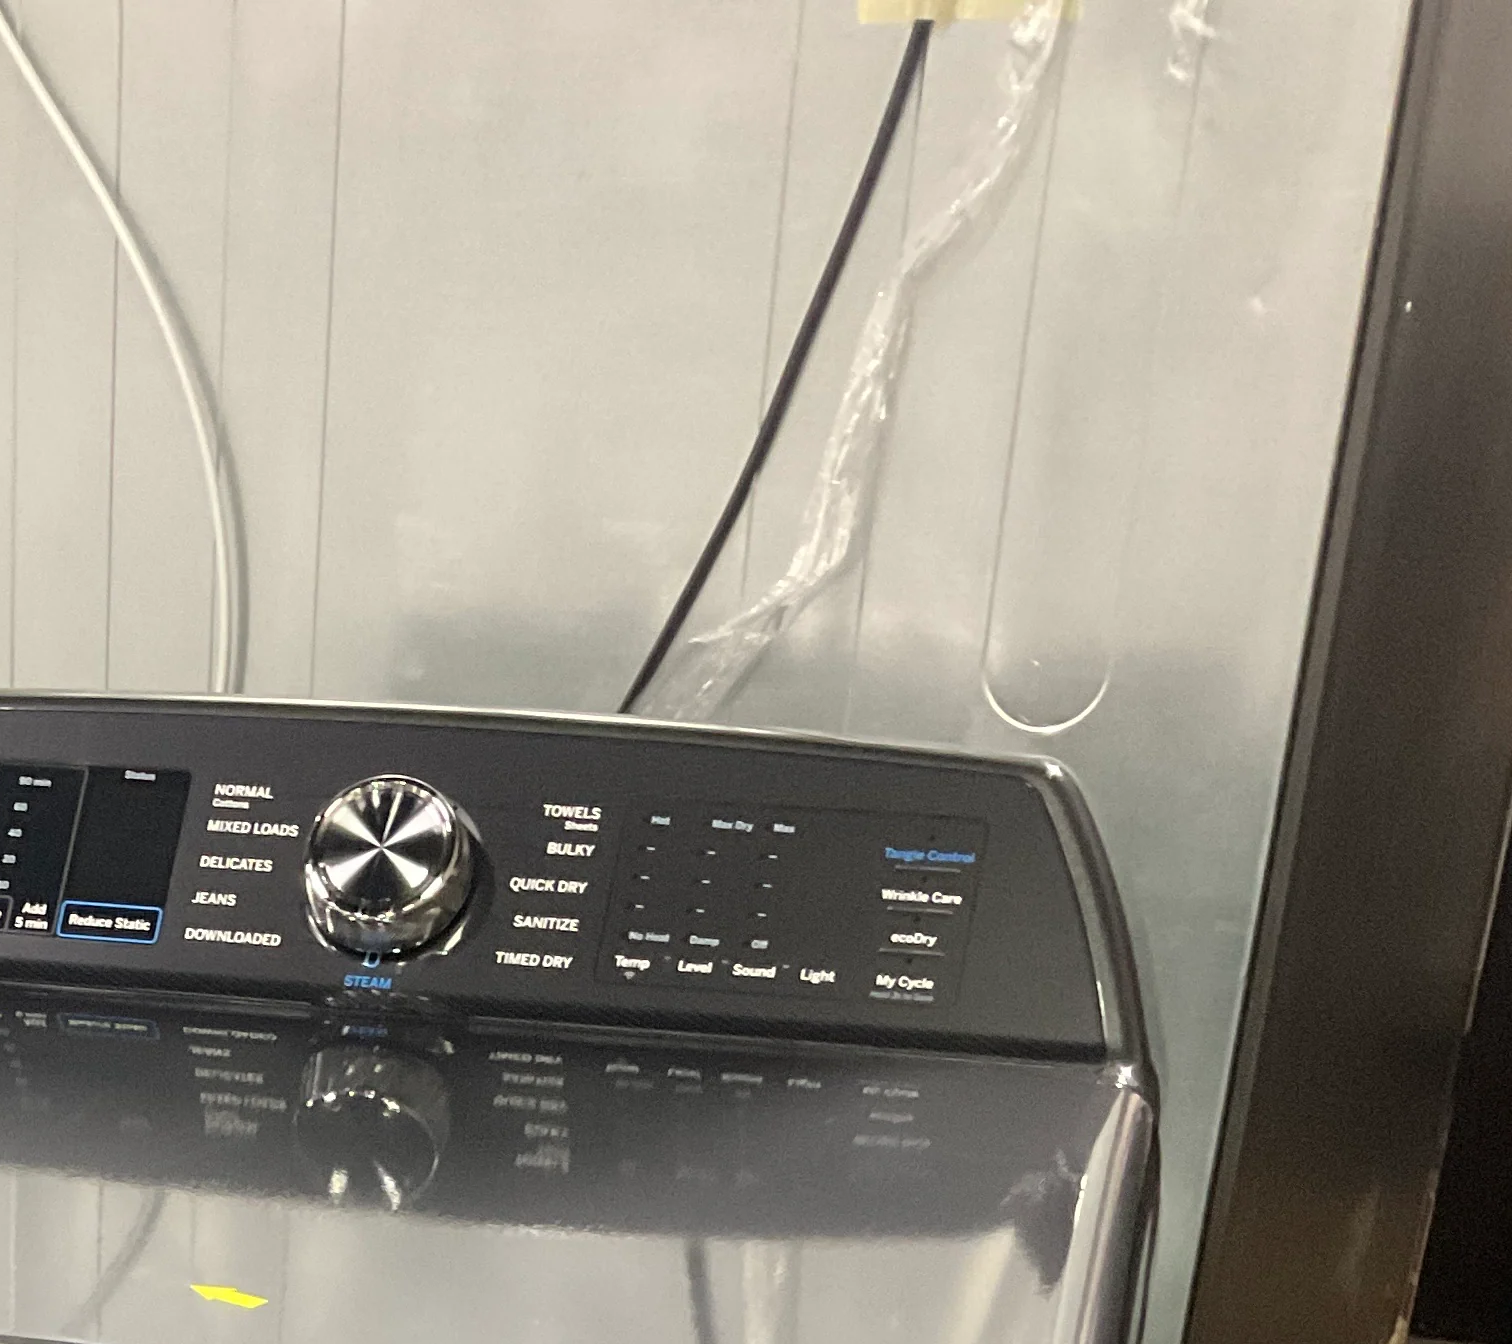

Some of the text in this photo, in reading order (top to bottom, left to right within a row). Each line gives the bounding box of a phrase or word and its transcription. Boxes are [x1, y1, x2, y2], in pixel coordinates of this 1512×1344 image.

[214, 784, 273, 800] NORMAL
[544, 804, 601, 819] TOWELS
[207, 820, 299, 837] MIXED LOADS
[547, 842, 595, 856] BULKY
[200, 855, 273, 872] DELICATES
[510, 877, 588, 893] QUICK DRY
[192, 892, 236, 906] JEANS
[882, 889, 962, 904] Wrinkle Care
[22, 903, 47, 915] Add
[14, 917, 48, 930] 5 min
[69, 914, 150, 931] Reduce Static
[513, 915, 579, 931] SANITIZE
[184, 928, 281, 946] DOWNLOADED
[891, 933, 937, 947] ecoDry
[496, 951, 572, 968] TIMED DRY
[615, 955, 650, 970] Temp
[678, 960, 713, 973] Level
[732, 964, 776, 978] Sound
[800, 969, 835, 984] Light
[344, 975, 392, 989] STEAM
[876, 975, 934, 990] My Cycle
